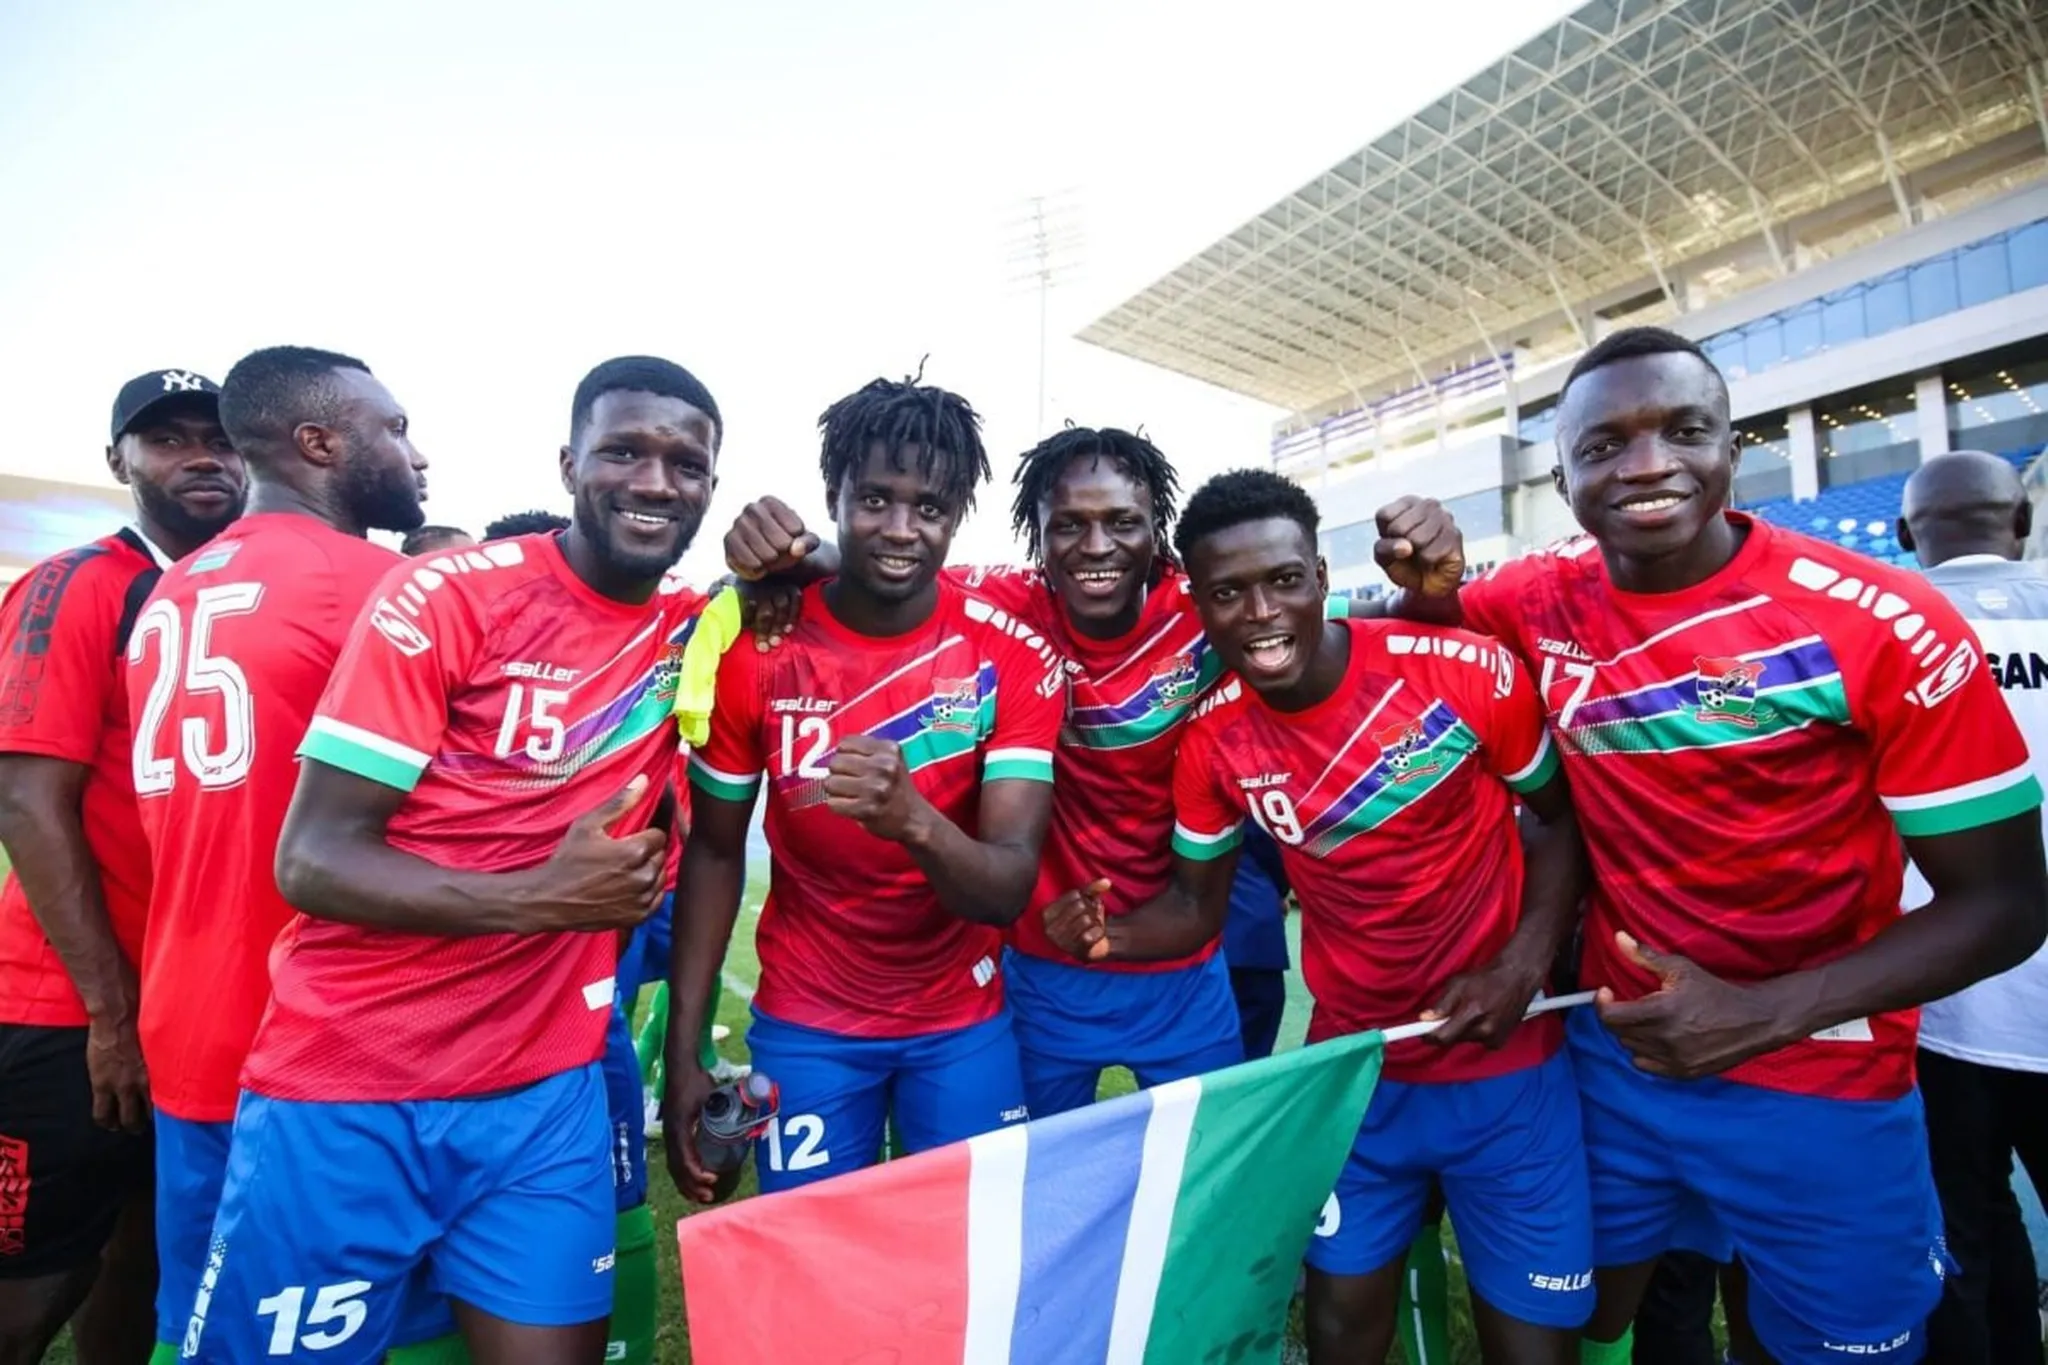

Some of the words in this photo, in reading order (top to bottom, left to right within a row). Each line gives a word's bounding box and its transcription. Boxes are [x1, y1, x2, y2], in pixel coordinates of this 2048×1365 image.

[129, 583, 266, 798] 25
[494, 682, 570, 763] 15
[1540, 656, 1597, 729] 17
[782, 714, 832, 780] 12
[1245, 790, 1304, 845] 19
[761, 1113, 831, 1172] 12
[257, 1280, 372, 1356] 15
